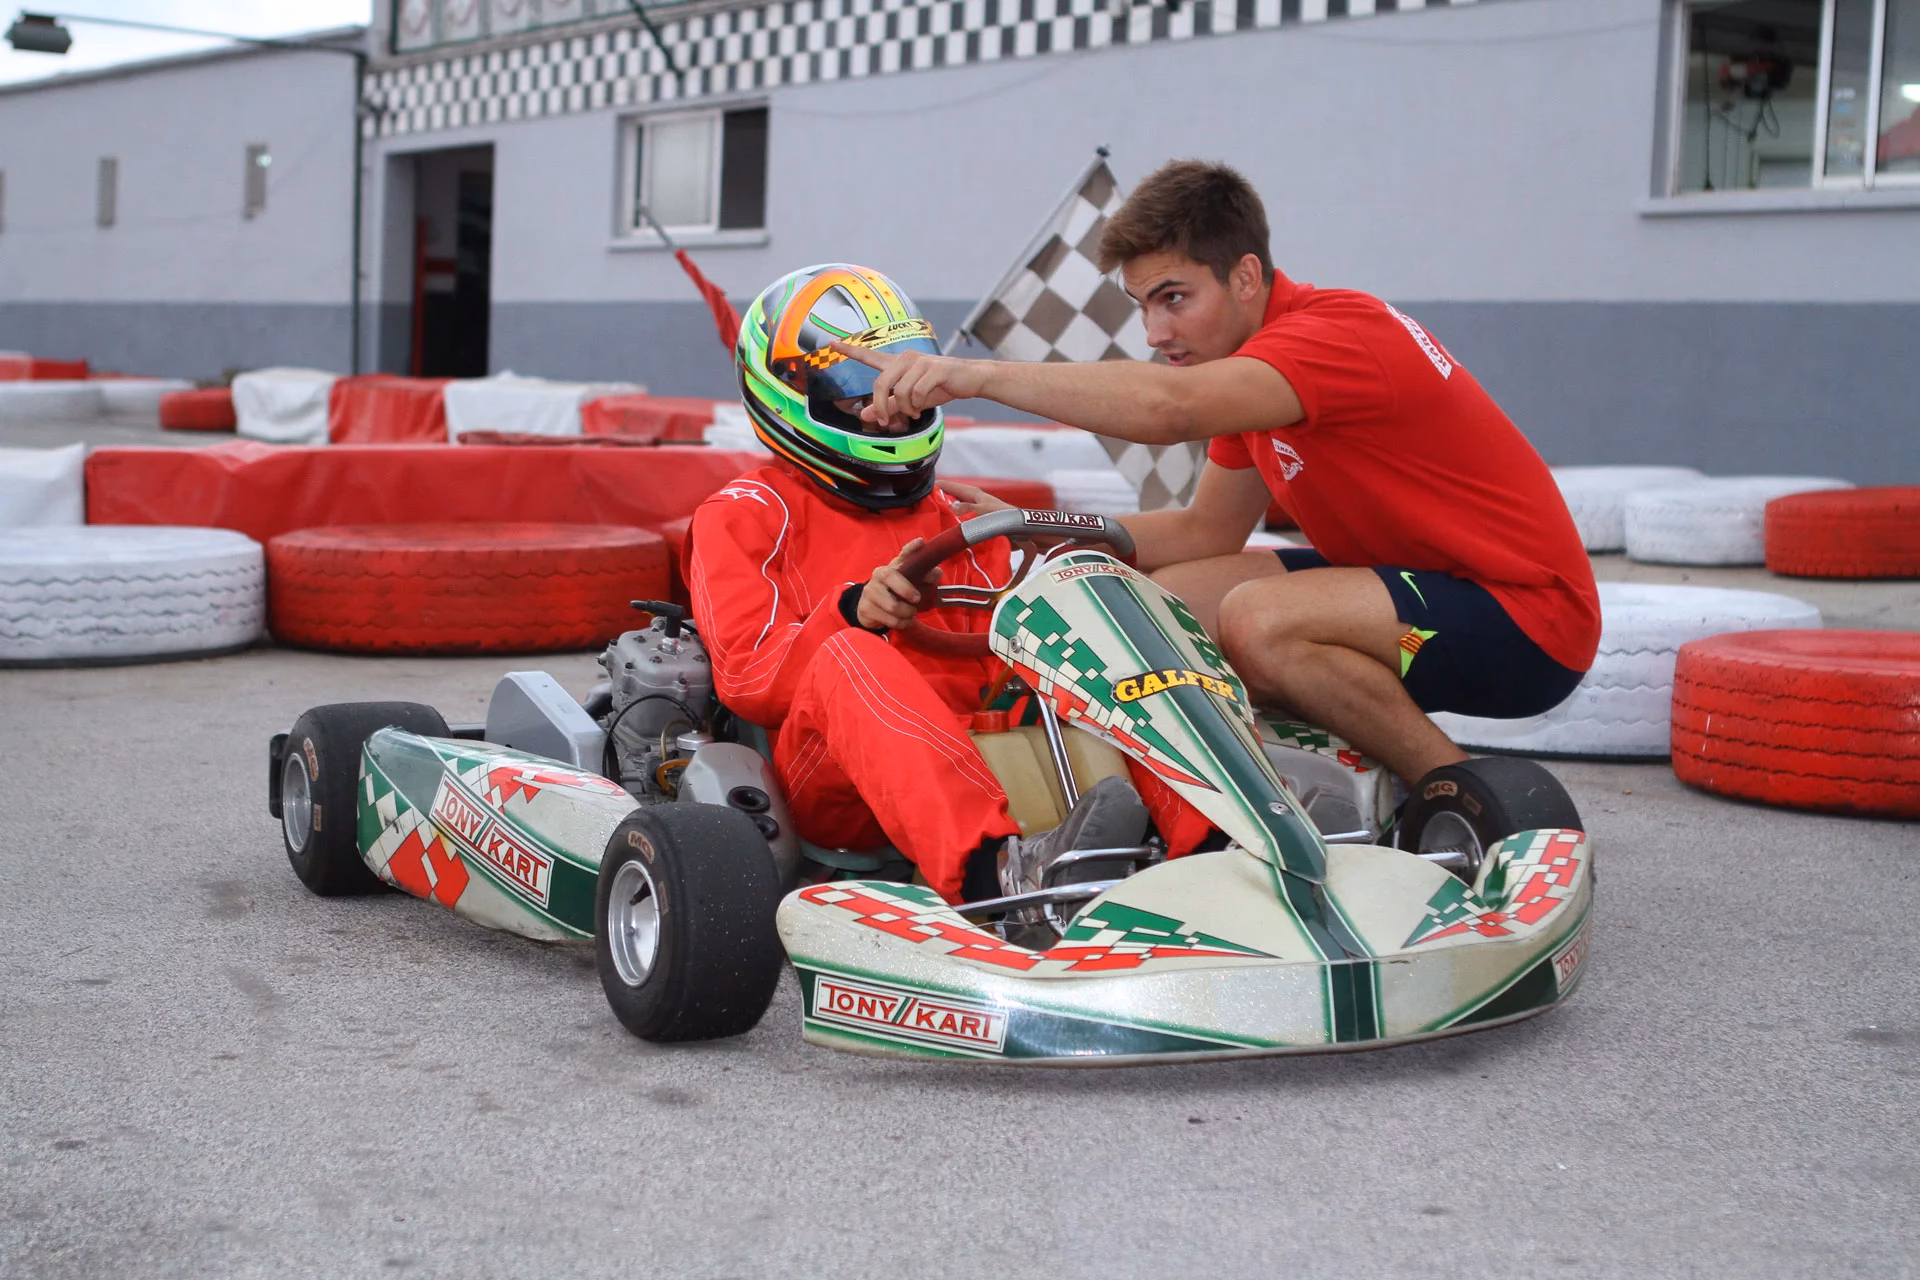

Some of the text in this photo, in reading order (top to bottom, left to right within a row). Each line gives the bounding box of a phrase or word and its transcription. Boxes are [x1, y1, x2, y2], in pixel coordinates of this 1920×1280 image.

[888, 321, 913, 332] LUCKY
[1028, 510, 1103, 527] TONY KART
[1055, 564, 1138, 581] TONY KART
[1115, 669, 1238, 702] GALFER
[1426, 782, 1454, 797] MG
[440, 780, 548, 888] TONY KART
[822, 983, 1001, 1039] TONY KART
